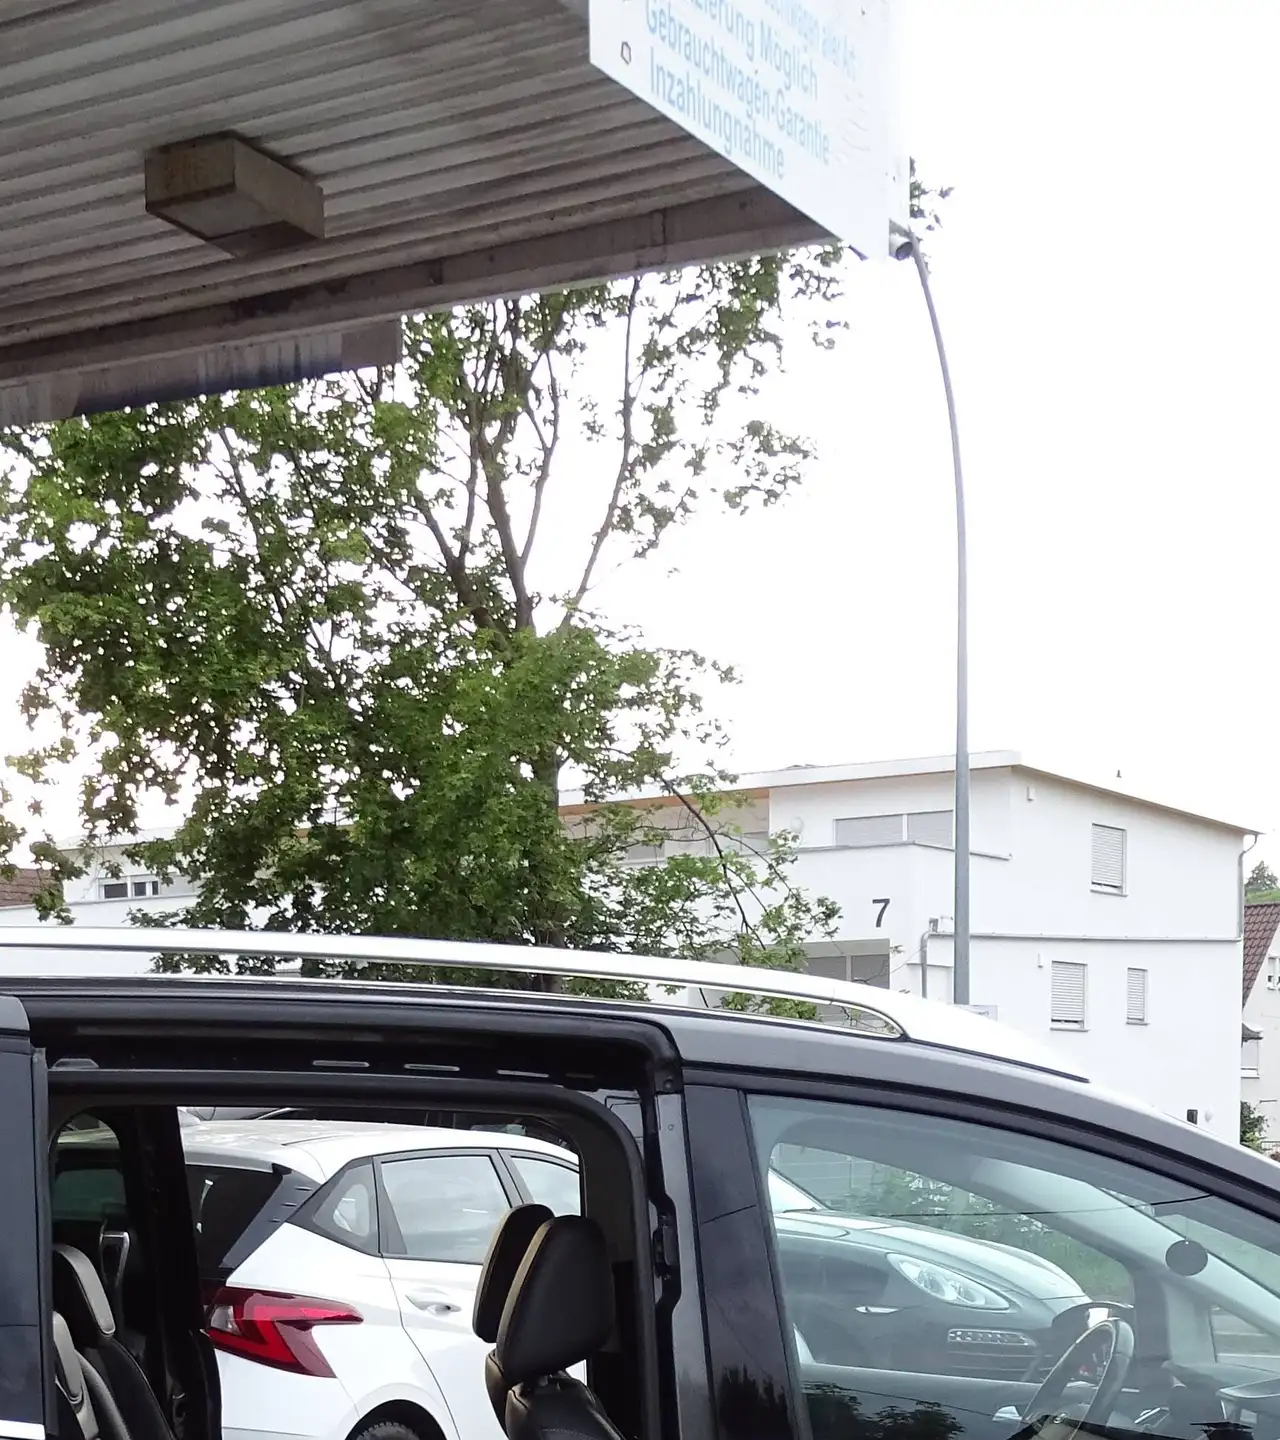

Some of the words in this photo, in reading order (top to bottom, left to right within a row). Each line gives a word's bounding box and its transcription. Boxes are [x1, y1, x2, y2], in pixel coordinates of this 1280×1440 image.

[645, 0, 829, 165] Gebrauchtwagen-Garantie
[650, 45, 785, 181] Inzahlungnahme
[760, 20, 818, 101] Möglich
[872, 898, 890, 928] 7
